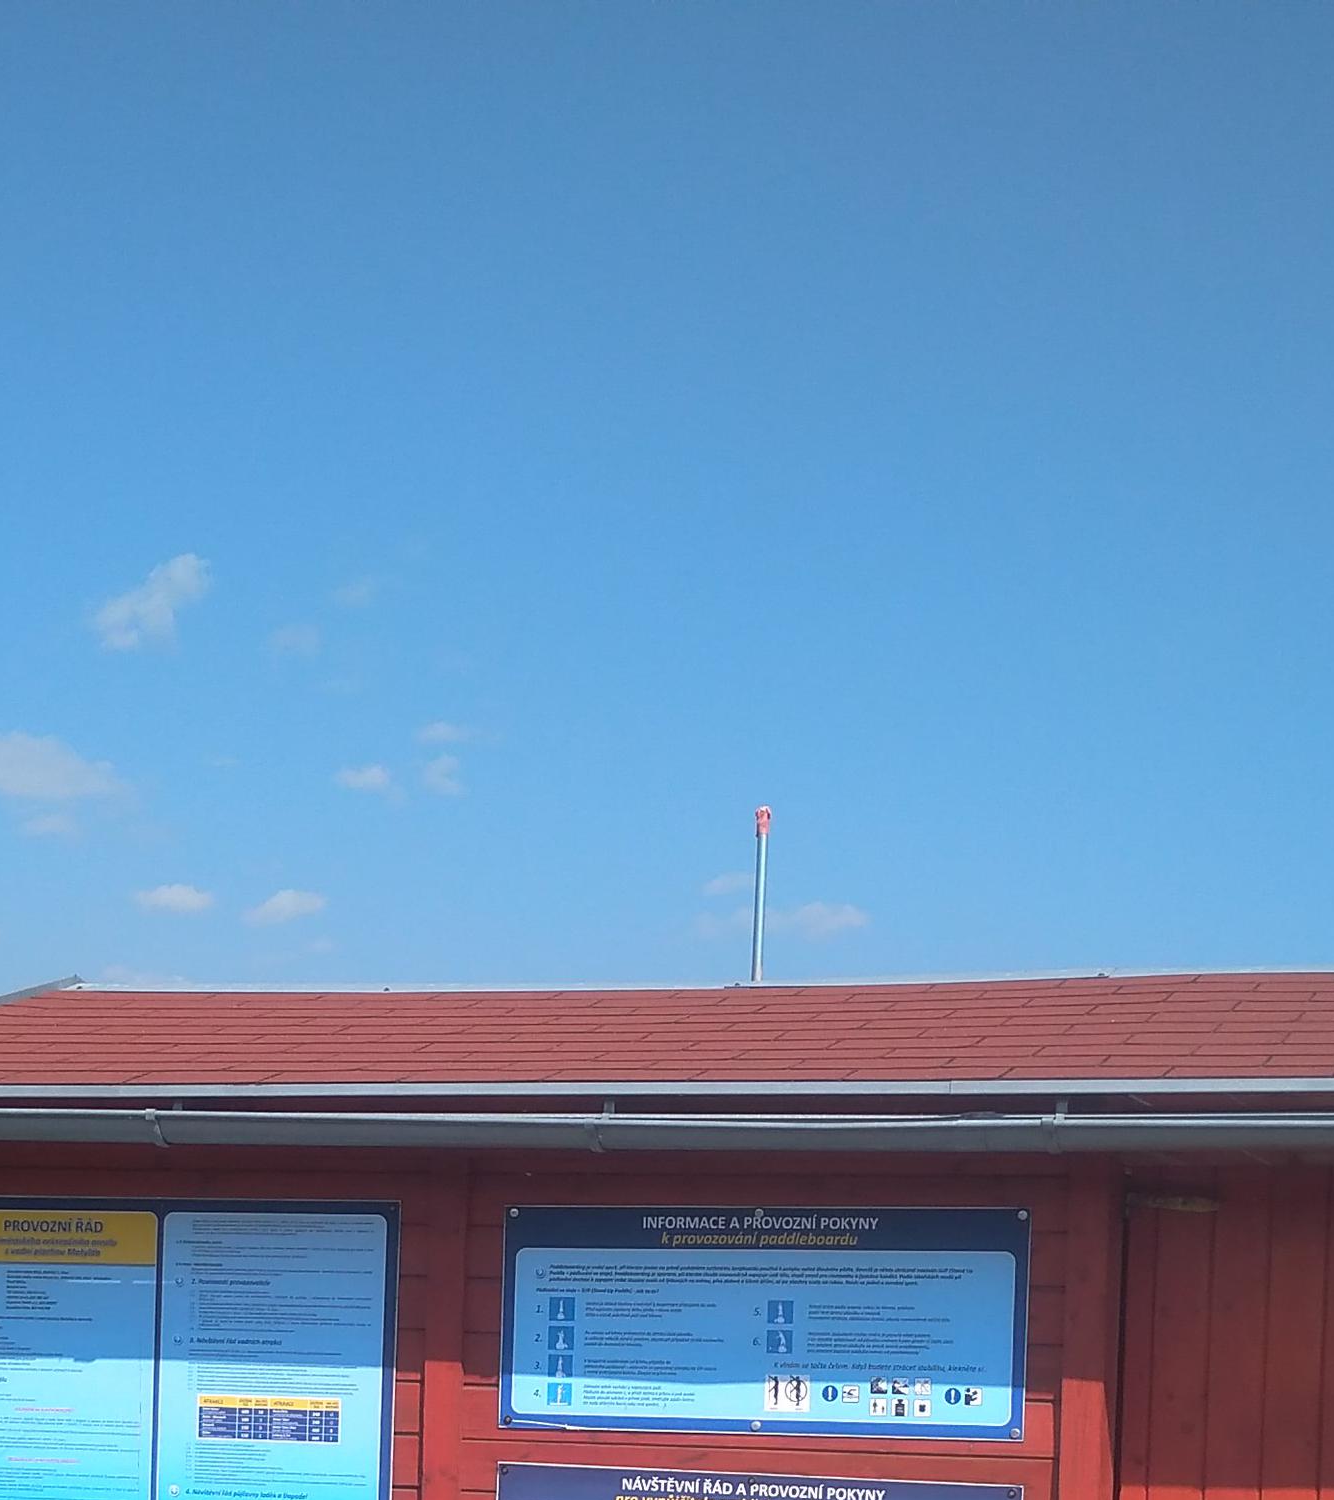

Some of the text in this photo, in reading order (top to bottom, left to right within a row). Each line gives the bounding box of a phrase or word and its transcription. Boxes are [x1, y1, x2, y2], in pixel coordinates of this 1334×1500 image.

[3, 1218, 103, 1233] PROVOZNÍ ŘÁD
[642, 1214, 879, 1230] INFORMACE A PROVOZNÍ POKYNY
[661, 1231, 858, 1247] k provozování paddleboardu
[753, 1307, 762, 1316] 5.
[534, 1333, 543, 1342] 2.
[752, 1337, 761, 1346] 6.
[534, 1361, 542, 1370] 3.
[533, 1389, 542, 1398] 4.
[621, 1477, 700, 1495] NÁVŠTĚVNÍ
[703, 1480, 733, 1496] ŘÁD
[736, 1484, 746, 1496] A
[750, 1483, 824, 1500] PROVOZNÍ
